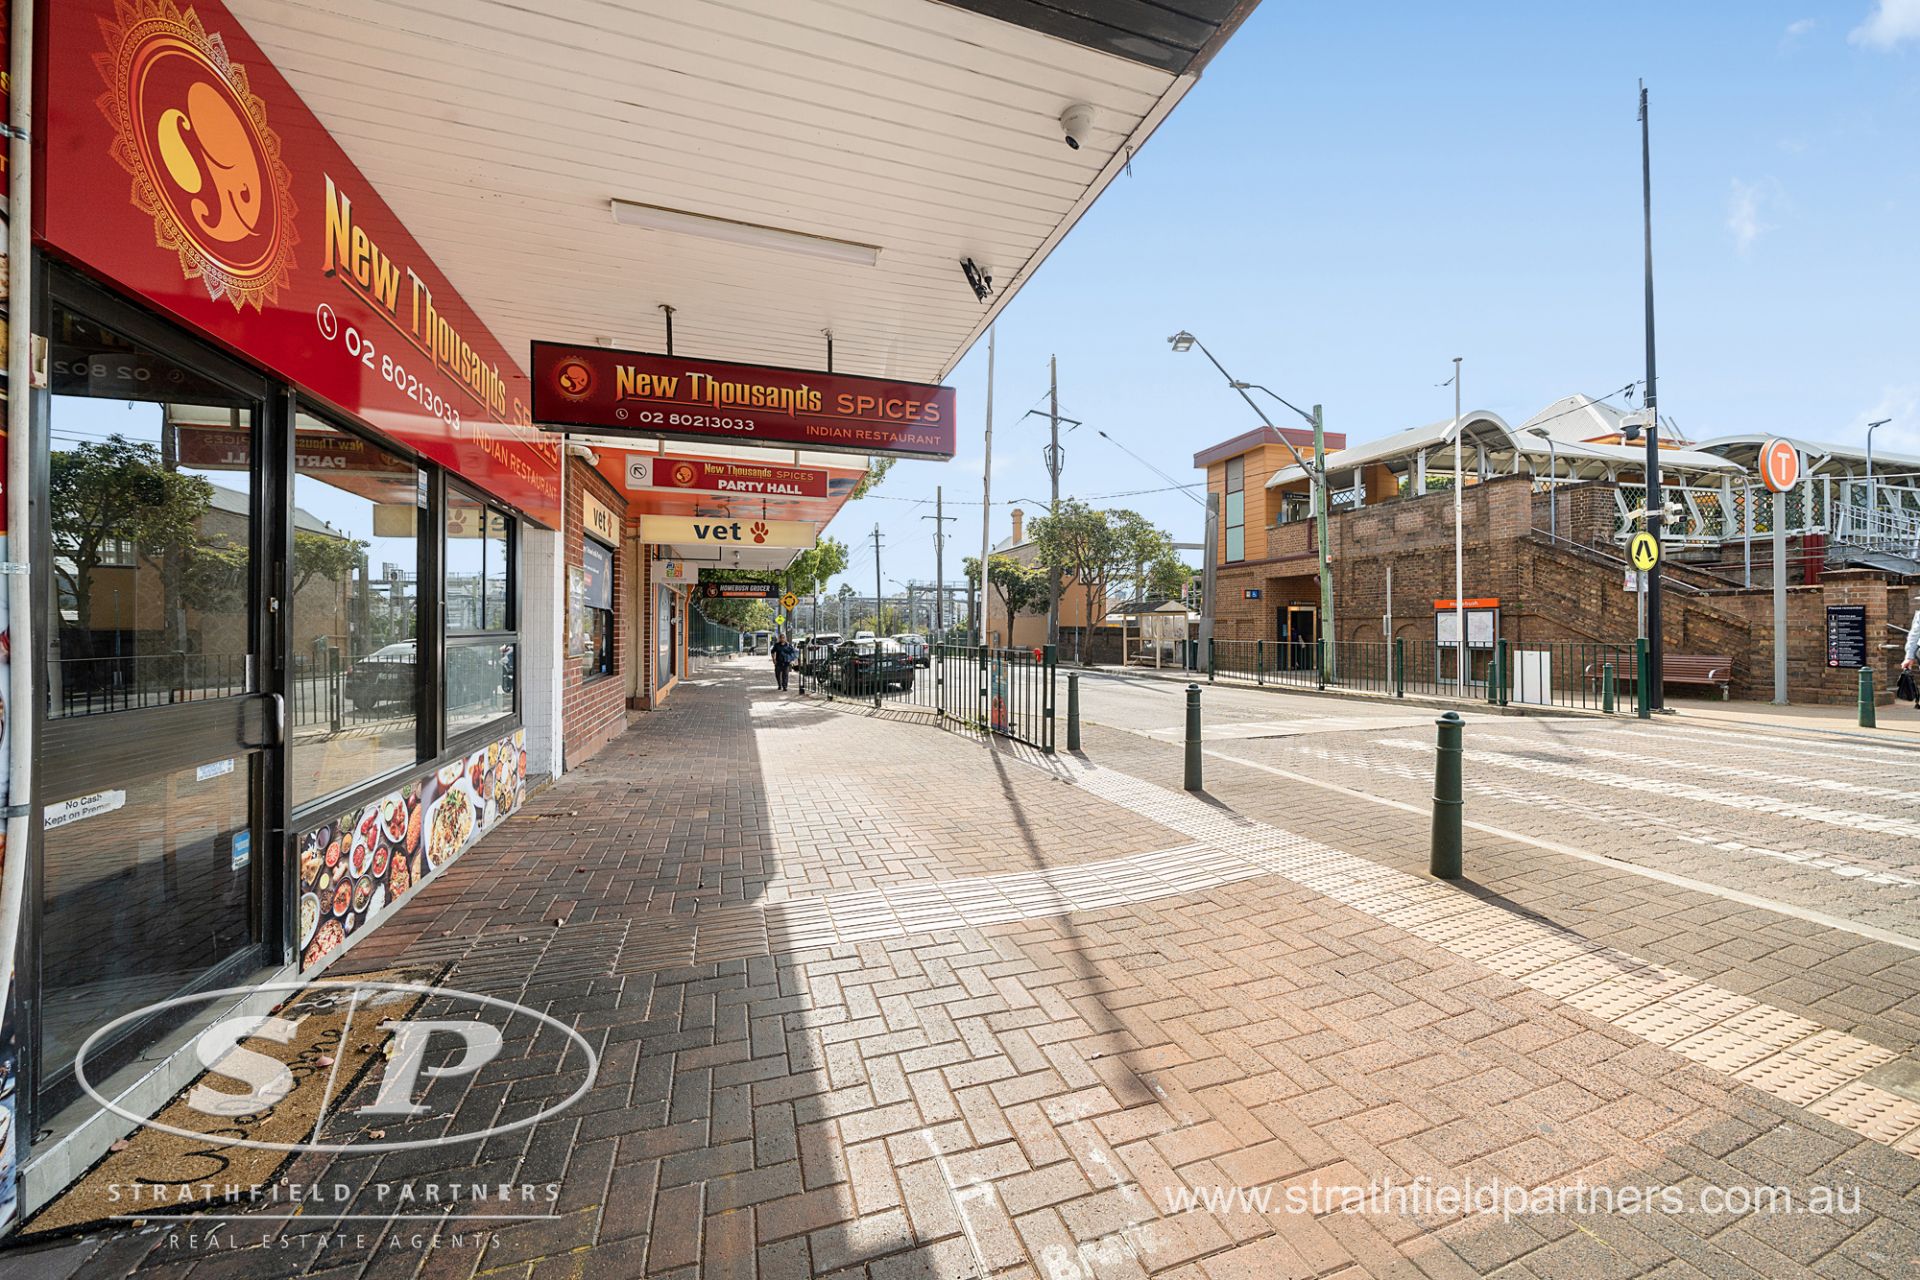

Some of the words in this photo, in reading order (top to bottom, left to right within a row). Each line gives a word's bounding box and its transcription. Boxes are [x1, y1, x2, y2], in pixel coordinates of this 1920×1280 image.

[321, 172, 400, 314] New
[407, 266, 506, 417] Thousands
[345, 327, 375, 369] 02
[381, 354, 460, 431] 80213033
[615, 364, 679, 401] New
[685, 371, 822, 418] Thousands
[836, 393, 941, 422] SPICES
[639, 411, 664, 424] 02
[669, 413, 755, 431] 80213033
[806, 425, 852, 439] INDIAN
[855, 430, 942, 446] RESTAURANT
[472, 424, 508, 467] INDIAN
[510, 452, 558, 500] RESTAURANT
[704, 463, 725, 475] New
[727, 464, 772, 479] Thousands
[776, 470, 814, 480] SPICES
[1776, 451, 1791, 481] T
[718, 479, 764, 492] PARTY
[767, 482, 802, 495] HALL
[592, 507, 607, 532] vet
[693, 522, 742, 541] vet
[719, 584, 749, 592] HOMEBUSH
[750, 584, 771, 592] GROCER
[65, 800, 79, 810] No
[80, 793, 103, 806] Cash
[44, 814, 67, 827] Kept
[68, 811, 81, 820] on
